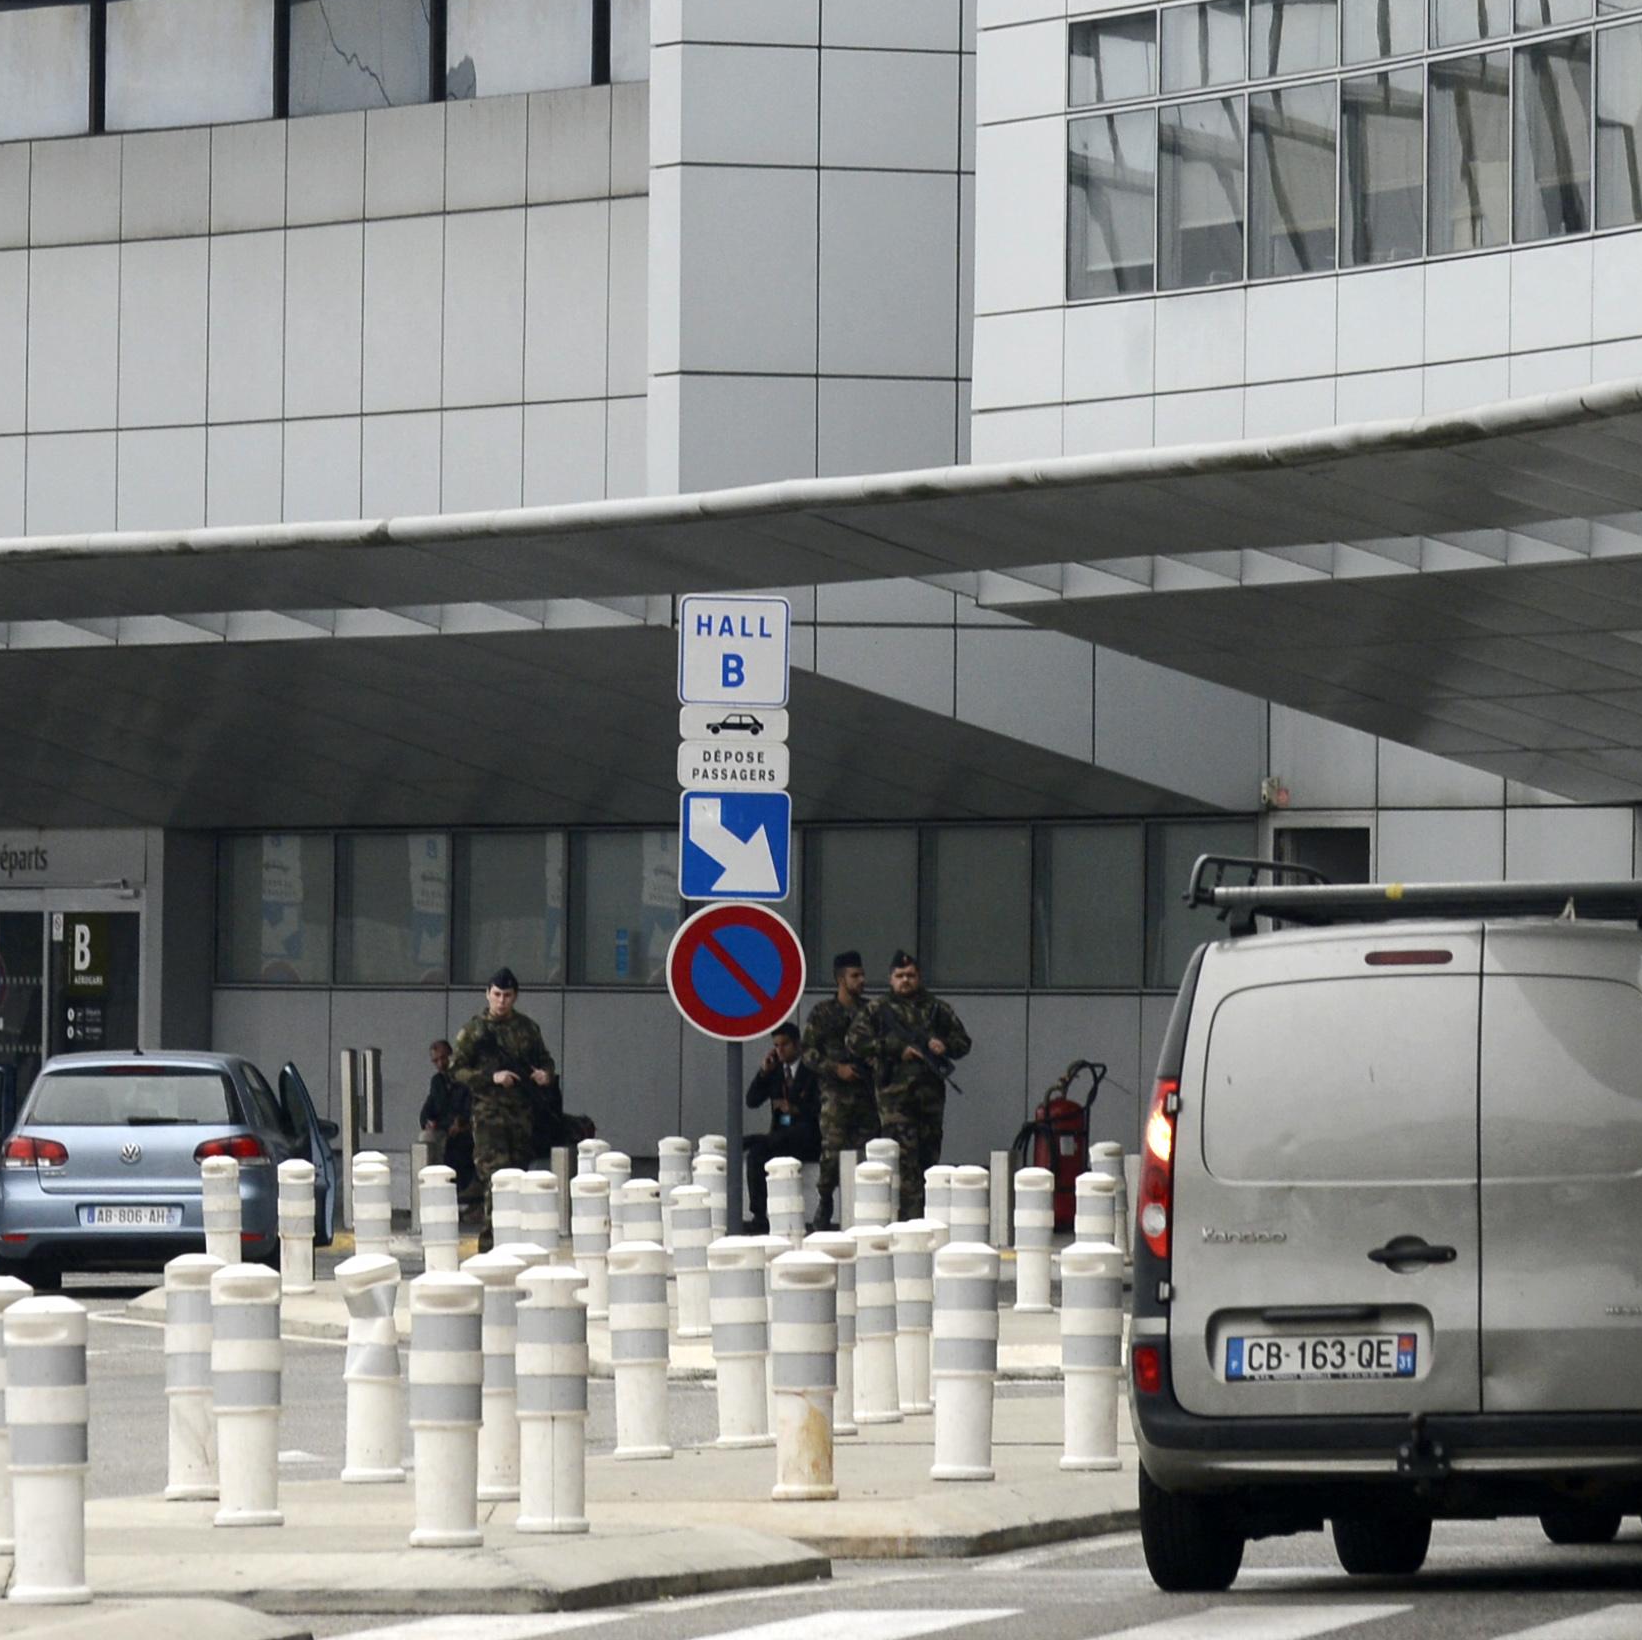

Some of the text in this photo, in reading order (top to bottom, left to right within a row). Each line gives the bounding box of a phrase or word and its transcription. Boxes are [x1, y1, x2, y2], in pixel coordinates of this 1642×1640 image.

[696, 613, 773, 638] HALL
[722, 653, 745, 688] B
[702, 748, 766, 764] DÉPOSE
[691, 767, 776, 782] PASSAGERS
[73, 923, 92, 972] B
[1247, 1339, 1393, 1372] CB-163-QE
